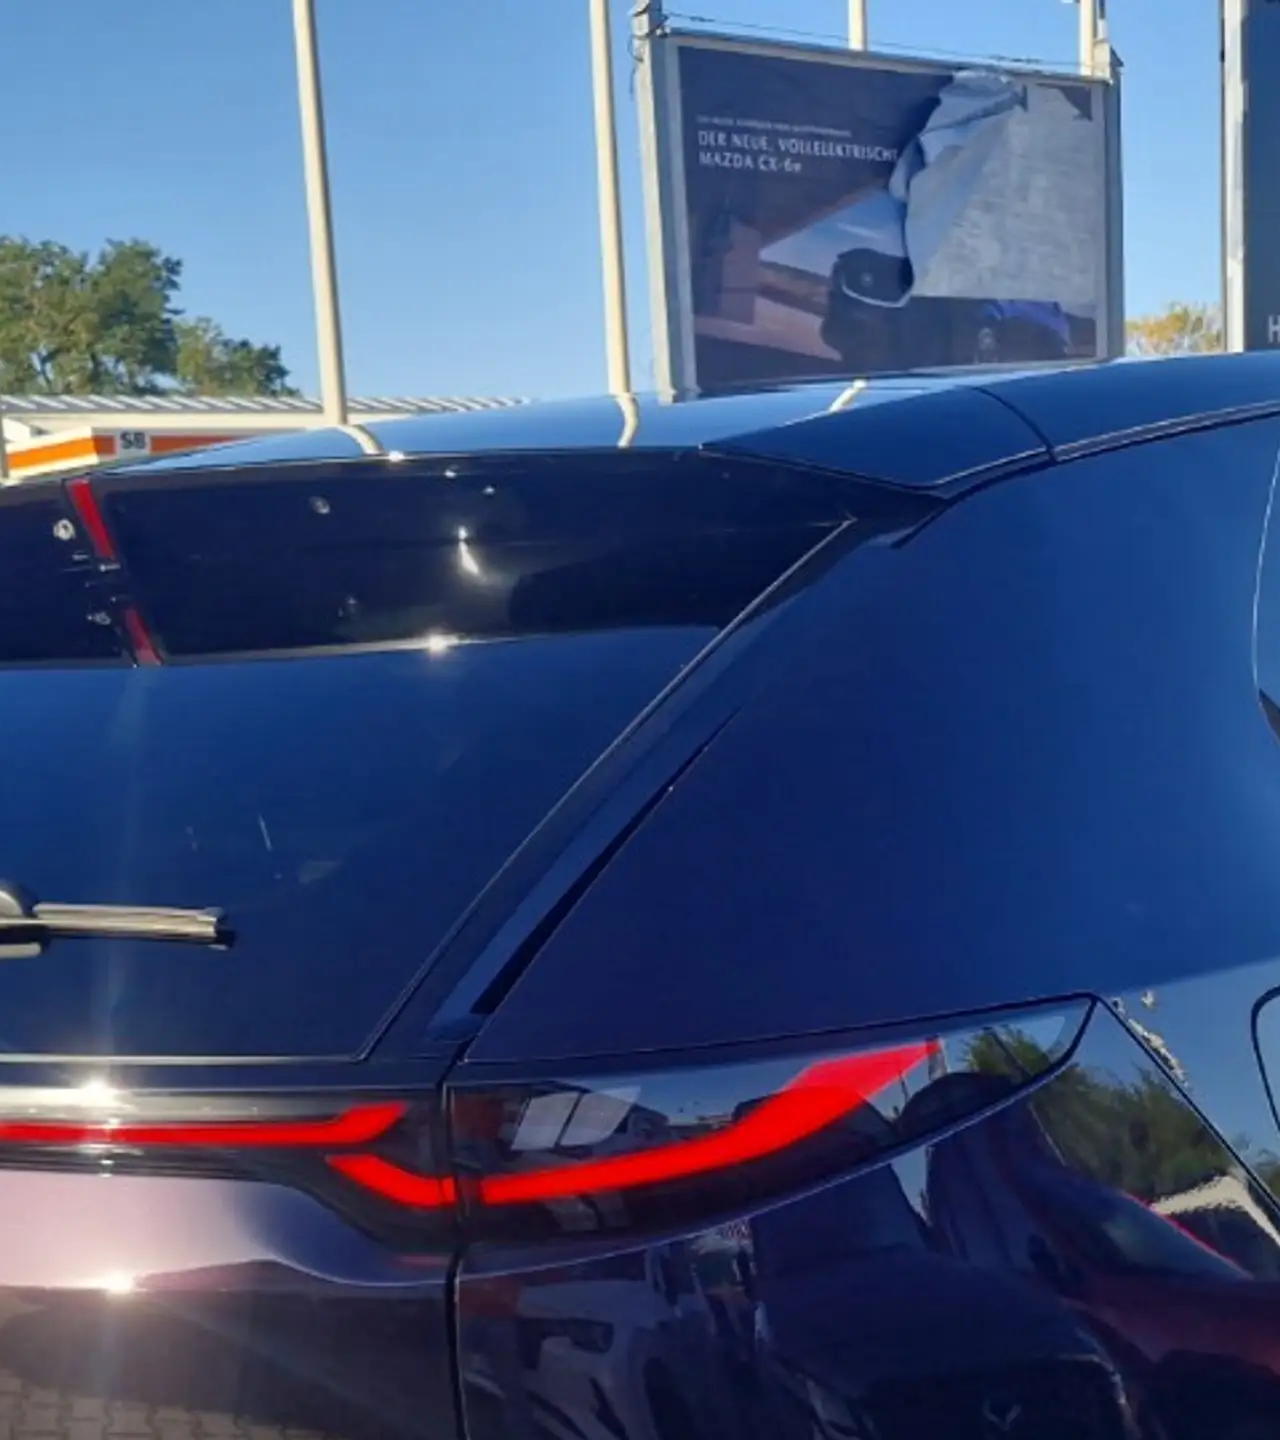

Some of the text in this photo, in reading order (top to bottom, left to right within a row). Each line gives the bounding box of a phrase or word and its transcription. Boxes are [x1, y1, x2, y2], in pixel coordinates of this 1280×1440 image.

[697, 130, 728, 147] DER
[698, 151, 754, 170] MAZDA
[119, 430, 146, 450] SB
